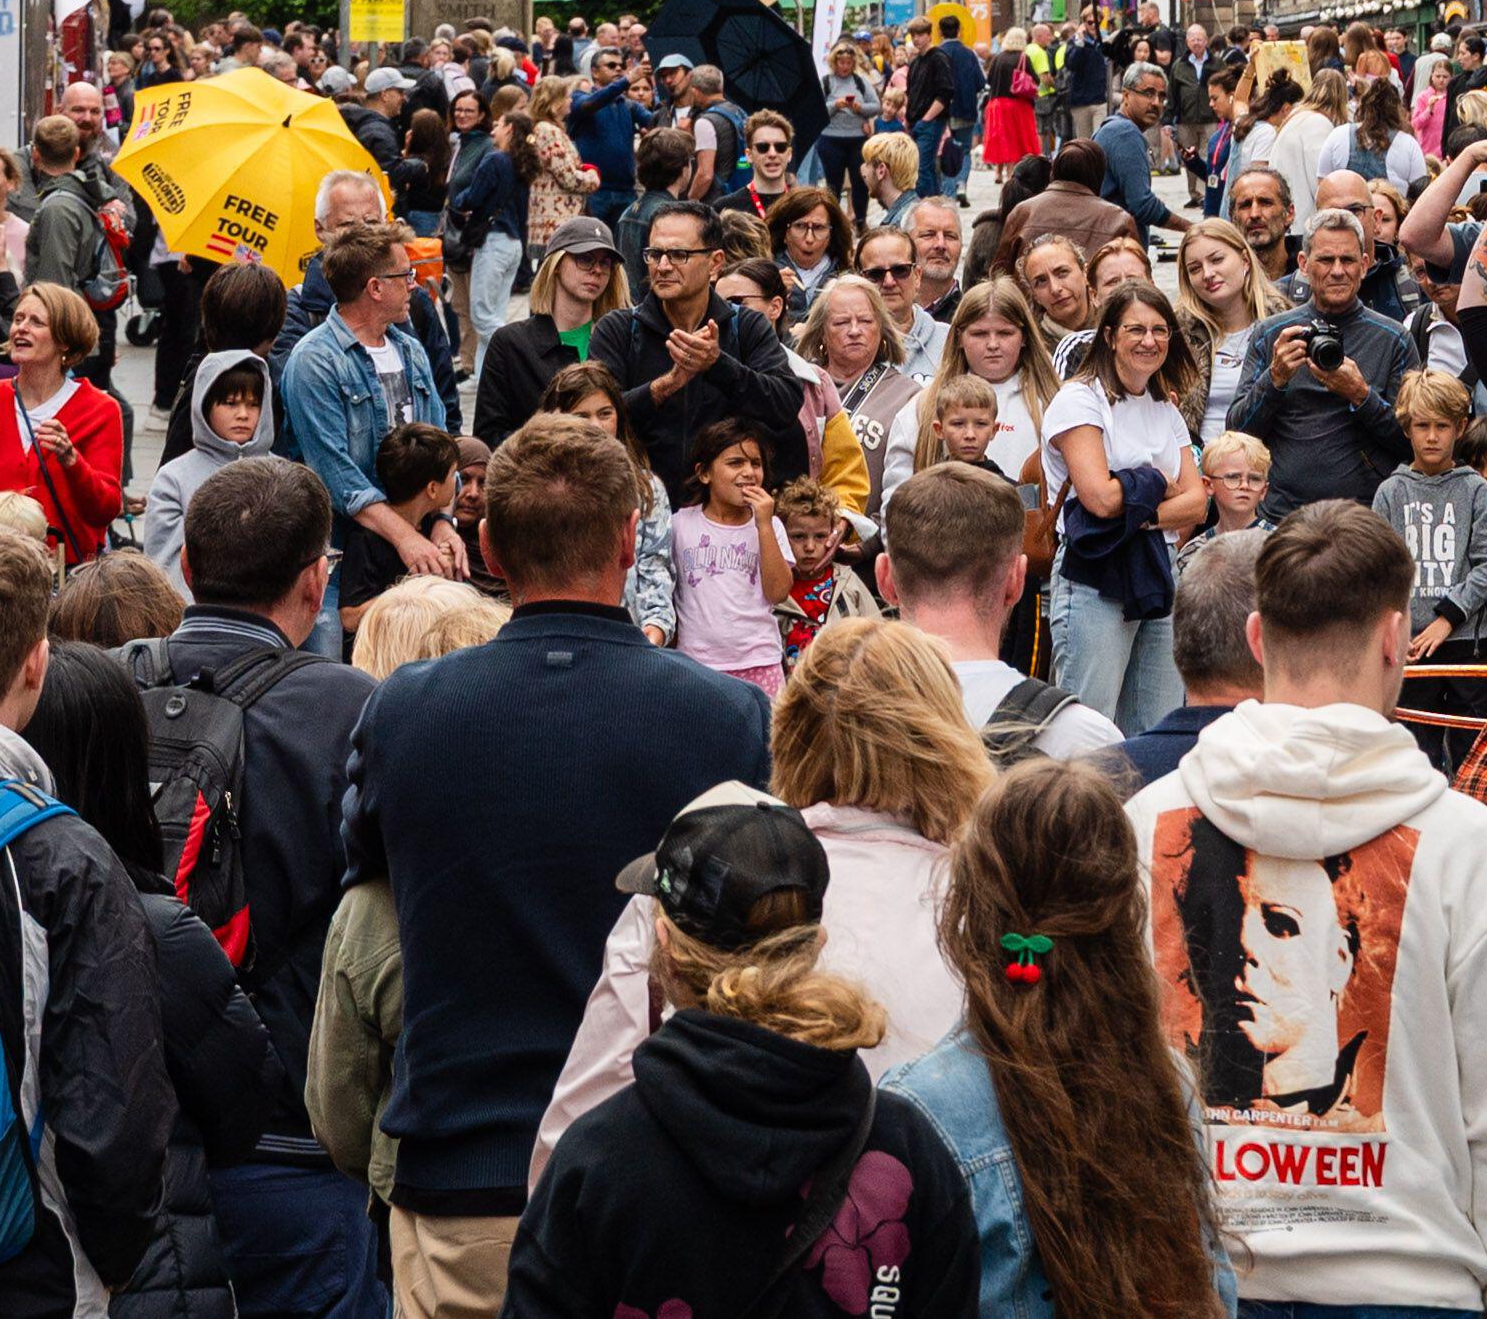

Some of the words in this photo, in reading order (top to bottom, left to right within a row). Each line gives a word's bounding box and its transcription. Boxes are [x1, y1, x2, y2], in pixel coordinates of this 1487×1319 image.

[438, 3, 495, 18] SMITH
[149, 99, 170, 135] TOUR
[170, 92, 191, 129] FREE
[223, 195, 279, 231] FREE
[218, 218, 269, 252] TOUR
[1404, 501, 1433, 525] IT'S
[1443, 503, 1455, 524] A
[1405, 524, 1455, 561] BIG
[1414, 561, 1455, 587] ITY
[1233, 1110, 1312, 1126] CARPENTER
[1314, 1119, 1339, 1127] FILM
[1216, 1140, 1387, 1187] LOWEEN
